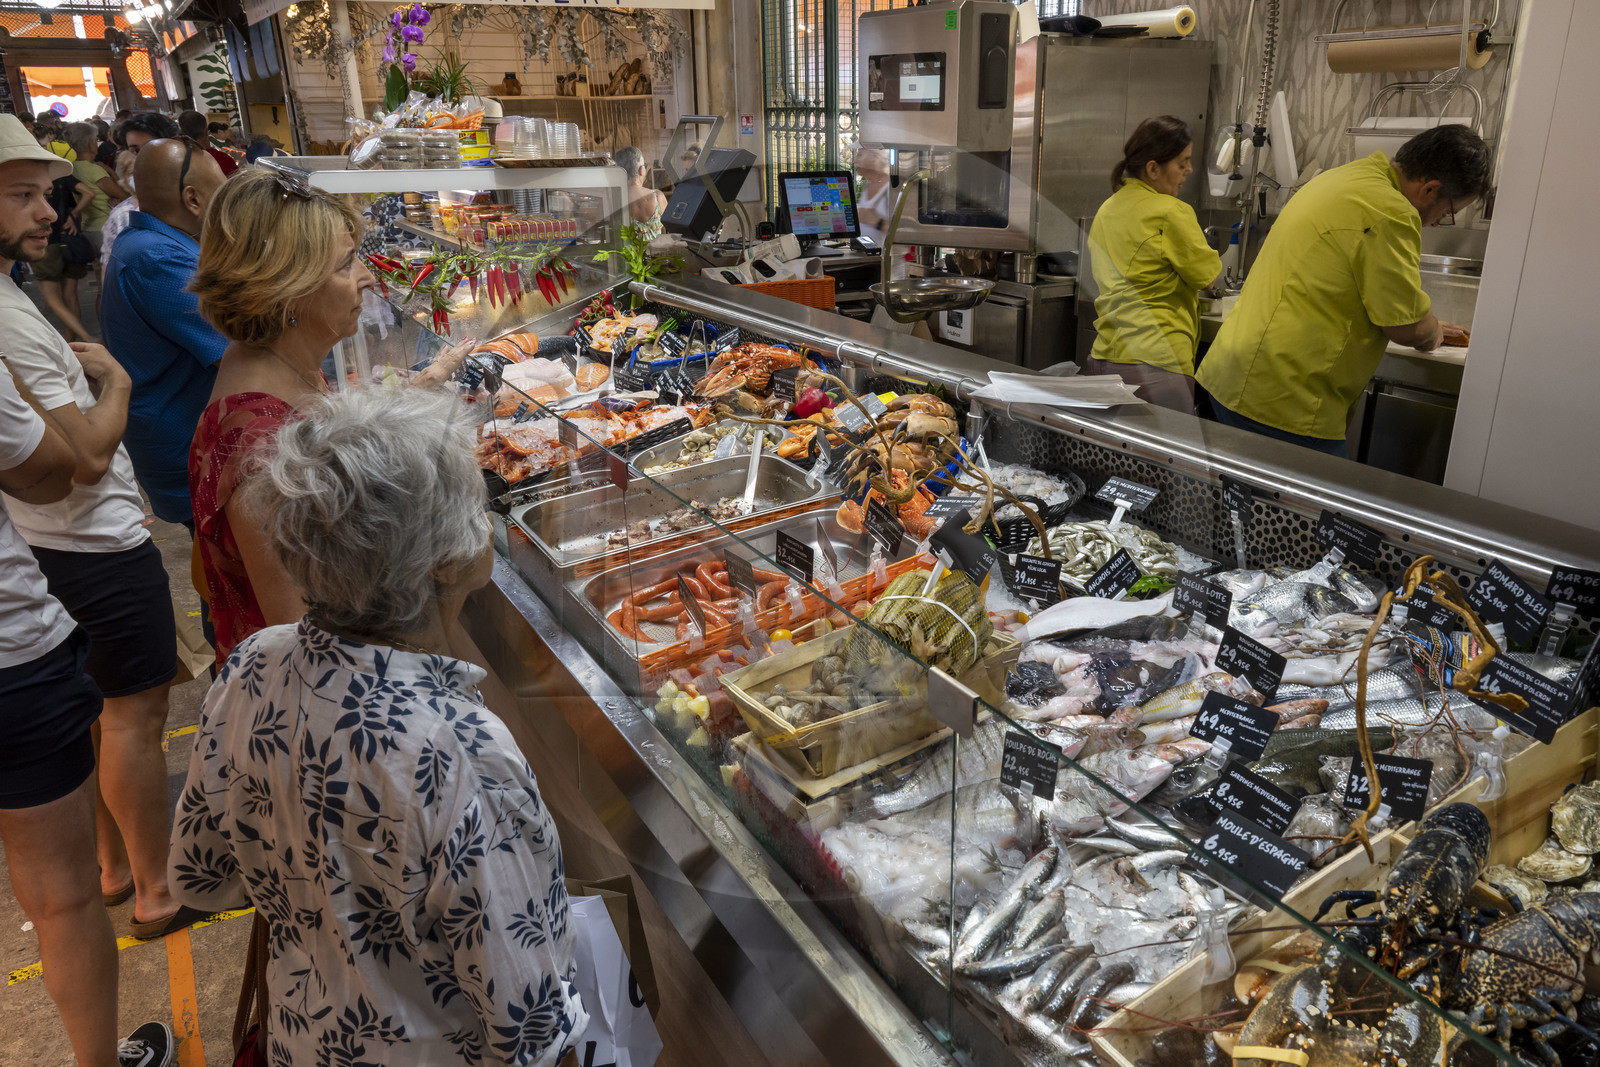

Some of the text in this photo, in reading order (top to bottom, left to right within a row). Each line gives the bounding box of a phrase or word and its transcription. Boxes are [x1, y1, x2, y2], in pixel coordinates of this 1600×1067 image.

[1319, 525, 1349, 548] 49.95€
[1015, 570, 1037, 585] 39.95€
[1088, 568, 1111, 592] ANCHOIS
[1555, 571, 1600, 587] BAR DE
[1177, 586, 1204, 609] 36.95€
[1181, 577, 1228, 603] QUEUE LOTTE
[1476, 580, 1508, 612] 55.90€
[1488, 565, 1547, 616] HOMARD BLEU
[1551, 584, 1597, 605] 49.95€
[1221, 644, 1251, 671] 29.95€
[1495, 669, 1523, 688] MARENNE
[1509, 663, 1526, 678] FINES
[1525, 673, 1534, 682] DE
[1533, 678, 1558, 695] CLAIRES
[1234, 703, 1248, 712] LOUP
[1199, 710, 1235, 736] 49.95€
[1005, 739, 1028, 753] POULPE
[1027, 745, 1036, 756] DE
[1003, 753, 1030, 776] 22.95€
[1229, 770, 1255, 789] SARDINES
[1351, 774, 1388, 797] 32.€
[1216, 782, 1244, 809] 8.95€
[1203, 834, 1238, 865] 6.95€
[1216, 816, 1251, 841] MOULE
[1249, 834, 1305, 870] D'ESPAGNE
